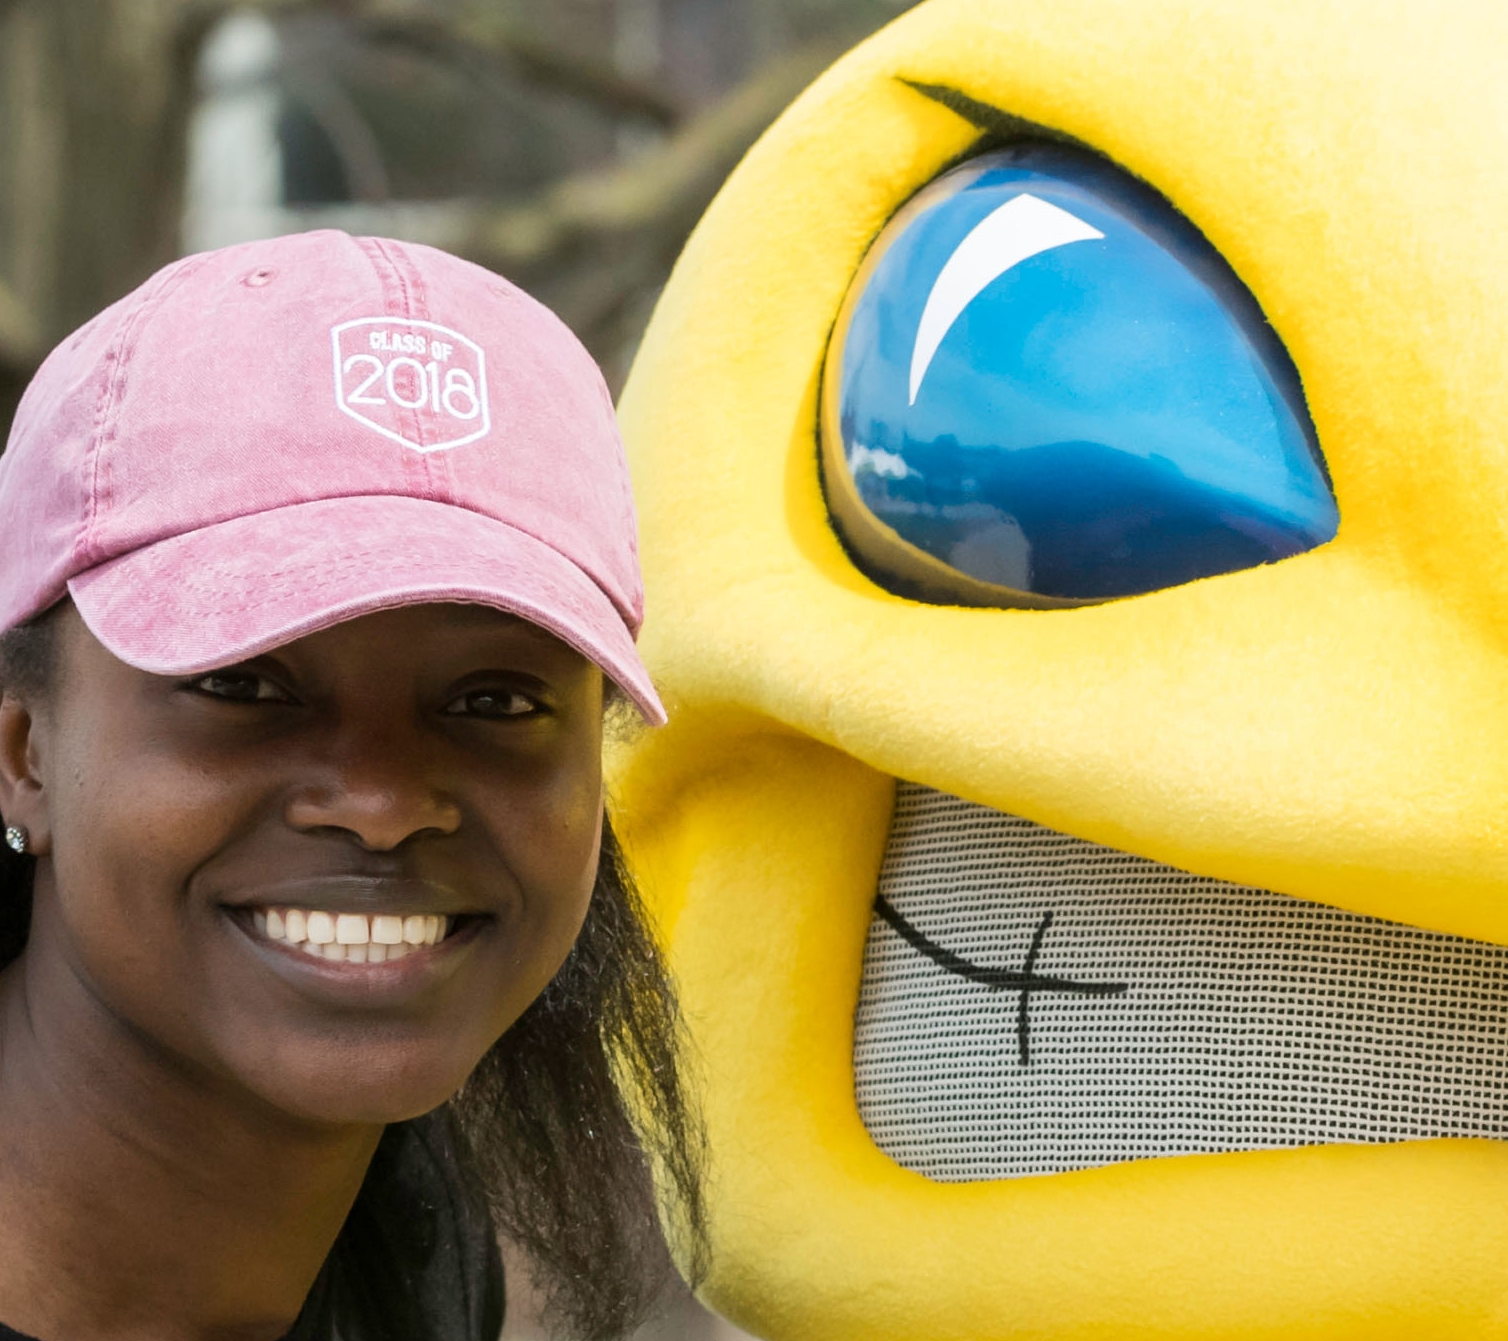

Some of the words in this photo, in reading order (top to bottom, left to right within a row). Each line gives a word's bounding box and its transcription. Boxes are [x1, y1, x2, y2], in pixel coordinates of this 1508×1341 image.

[369, 330, 426, 355] CLASS
[430, 340, 453, 362] OF
[342, 354, 480, 420] 2018
